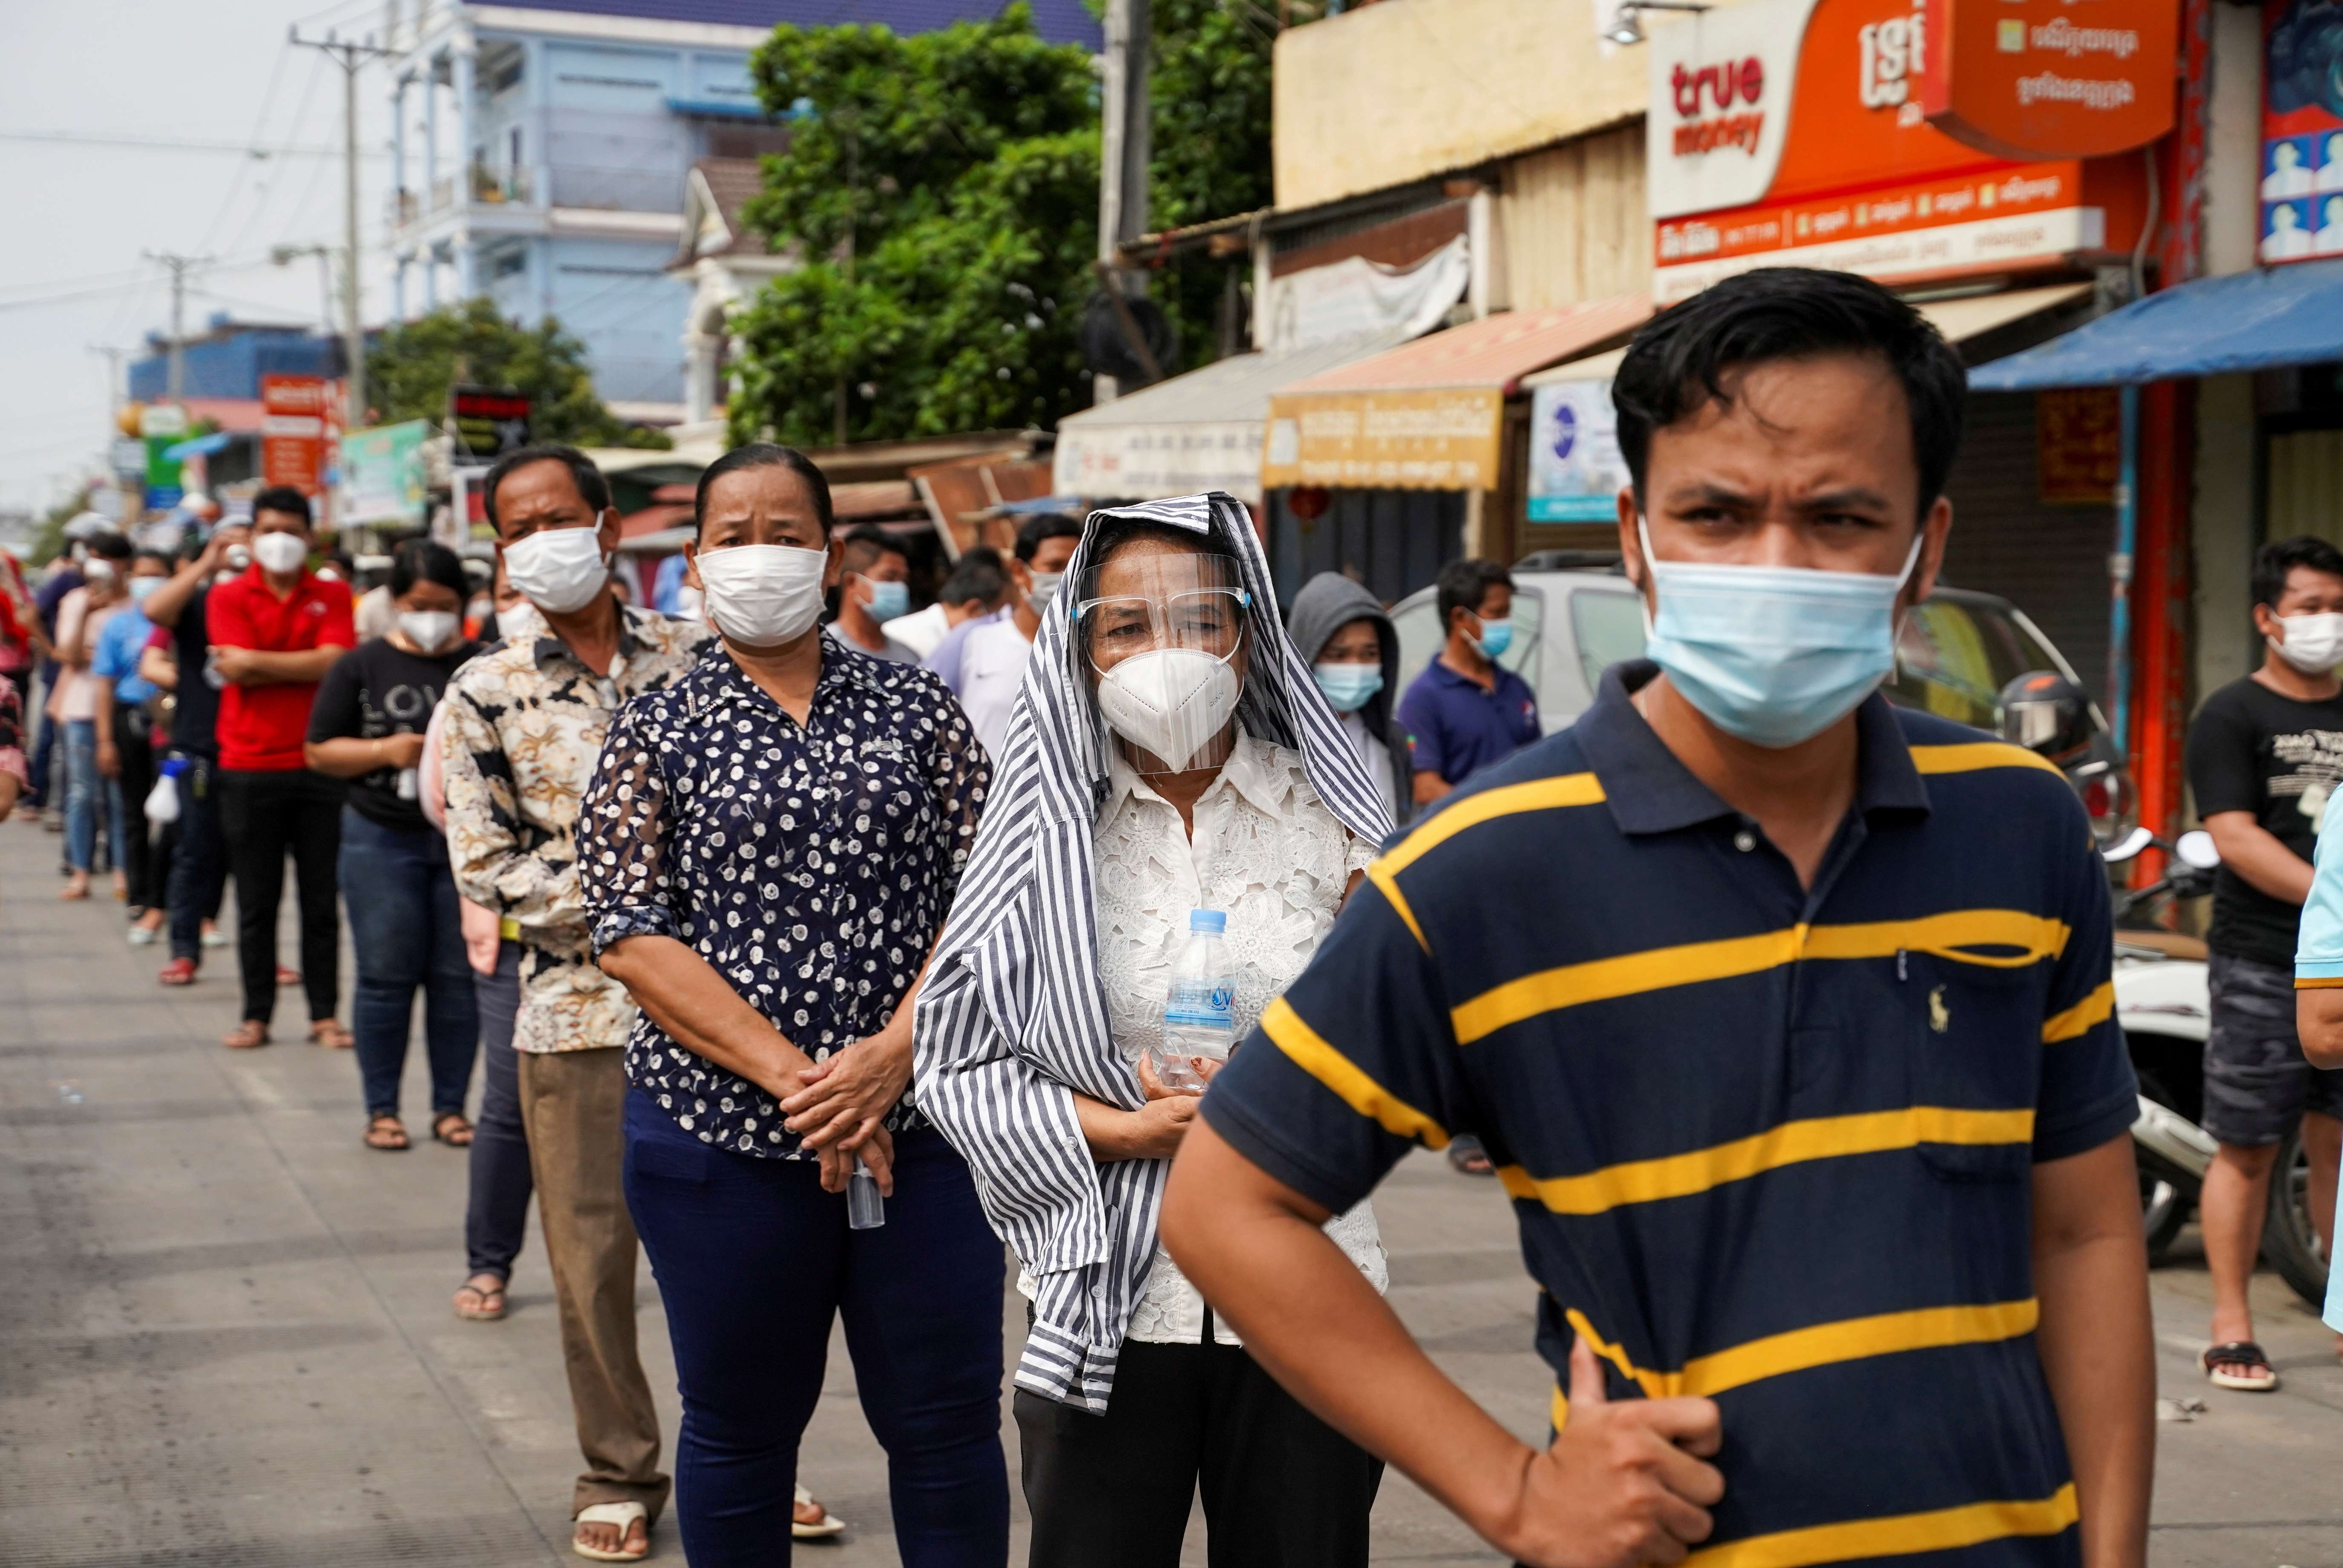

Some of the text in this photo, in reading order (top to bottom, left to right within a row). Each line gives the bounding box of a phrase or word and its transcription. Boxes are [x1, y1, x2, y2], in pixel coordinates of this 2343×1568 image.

[1671, 56, 1763, 117] true
[1674, 112, 1765, 157] money
[1209, 690, 1224, 709] KN95
